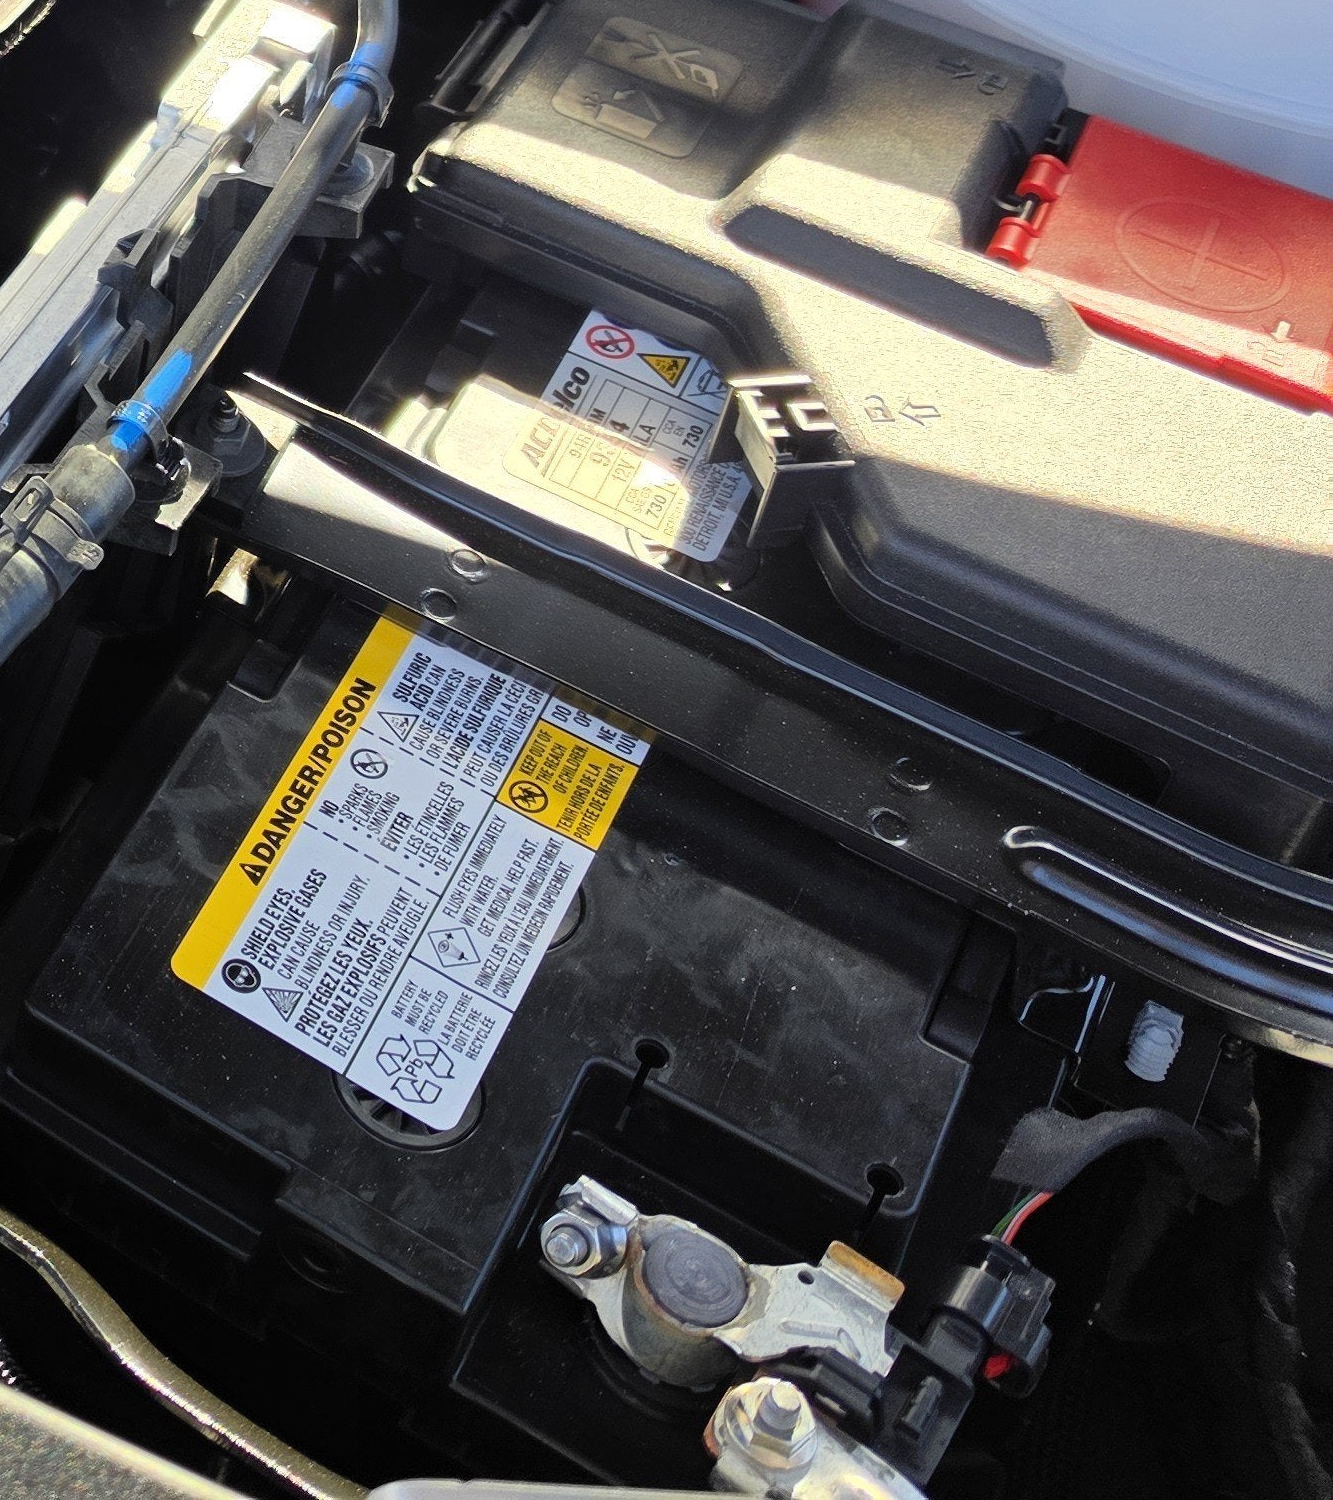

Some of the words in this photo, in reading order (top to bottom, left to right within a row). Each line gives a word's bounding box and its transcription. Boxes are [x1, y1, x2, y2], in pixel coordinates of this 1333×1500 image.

[682, 424, 705, 448] 730
[644, 492, 670, 521] 730
[682, 466, 730, 529] RENAISSANCE
[392, 652, 432, 703] SULFURIC
[409, 683, 435, 712] ACID
[425, 664, 447, 687] CAN
[453, 675, 484, 710] BURNS.
[504, 679, 527, 704] CÉCI
[409, 717, 438, 751] CAUSE
[426, 667, 466, 721] BLINDNESS
[497, 702, 516, 718] LA
[525, 688, 544, 705] GR
[551, 704, 572, 723] DO
[434, 706, 465, 745] SEVERE
[442, 729, 475, 770] L'ACIDE
[462, 672, 507, 734] SULFURIQUE
[476, 714, 509, 754] CAUSER
[498, 702, 536, 754] BRÛLURES
[536, 728, 553, 743] OF
[596, 725, 618, 744] NE
[426, 742, 445, 759] OR
[463, 750, 487, 779] PEUT
[488, 750, 510, 773] DES
[519, 754, 539, 777] KEEP
[528, 738, 547, 758] OUT
[543, 742, 568, 772] REACH
[558, 744, 589, 784] CHILDREN.
[250, 676, 377, 865] DANGER/POISON
[480, 769, 499, 787] OU
[535, 766, 555, 785] THE
[552, 779, 568, 794] OF
[579, 773, 597, 788] DE
[585, 762, 603, 778] LA
[594, 762, 626, 801] ENFANTS.
[318, 799, 340, 819] NO
[338, 782, 369, 820] SPARKS
[352, 789, 383, 828] FLAMES
[366, 791, 401, 835] SMOKING
[412, 780, 455, 837] ÉTINCELLES
[568, 784, 591, 811] HORS
[588, 796, 607, 812] DE
[378, 811, 415, 853] ÉVITER
[418, 842, 440, 864] LES
[429, 796, 465, 845] FLAMMES
[556, 807, 580, 832] TENIR
[573, 807, 601, 842] PORTÉE
[403, 834, 425, 856] LES
[441, 821, 472, 858] FUMER
[516, 837, 540, 863] FAST.
[433, 854, 453, 872] DE
[442, 887, 468, 919] FLUSH
[457, 867, 479, 892] EYES
[469, 813, 507, 872] IMMEDIATELY
[505, 859, 527, 886] HELP
[521, 836, 565, 901] IMMÉDIATEMENT.
[336, 874, 371, 916] INJURY.
[459, 902, 483, 928] WITH
[471, 874, 499, 906] WATER.
[486, 883, 517, 922] MEDICAL
[538, 860, 575, 912] RAPIDEMENT.
[241, 917, 276, 960] SHIELD
[264, 887, 296, 921] EYES.
[257, 904, 307, 971] EXPLOSIVE
[294, 868, 328, 908] GASES
[327, 913, 348, 932] OR
[392, 898, 430, 950] AVEUGLE.
[510, 896, 533, 922] L'EAU
[521, 907, 550, 945] MÉDECIN
[477, 917, 497, 937] GET
[497, 923, 519, 945] YEUX
[277, 954, 301, 980] CAN
[290, 919, 321, 957] CAUSE
[294, 929, 338, 991] BLINDNESS
[489, 943, 509, 963] LES
[515, 940, 533, 956] UN
[294, 971, 342, 1037] PROTÉGEZ
[328, 949, 354, 976] LES
[341, 917, 374, 952] YEUX.
[312, 1020, 339, 1048] LES
[326, 994, 353, 1023] GAZ
[340, 933, 387, 999] EXPLOSIFS
[376, 886, 413, 937] PEUVENT
[368, 945, 403, 991] RENDRE
[474, 957, 501, 990] RINCEZ
[492, 952, 527, 999] CONSULTEZ
[359, 987, 379, 1008] OU
[390, 979, 419, 1019] BATTERY
[404, 999, 426, 1027] MUST
[417, 988, 433, 1003] BE
[418, 990, 449, 1035] RECYCLED
[443, 991, 474, 1033] BATTERIE
[331, 1005, 370, 1058] BLESSER
[460, 1007, 483, 1032] ÊTRE
[437, 1031, 453, 1046] LA
[451, 1029, 471, 1054] DOIT
[465, 1015, 497, 1061] RECYCLÉE
[404, 1057, 425, 1078] Pb
